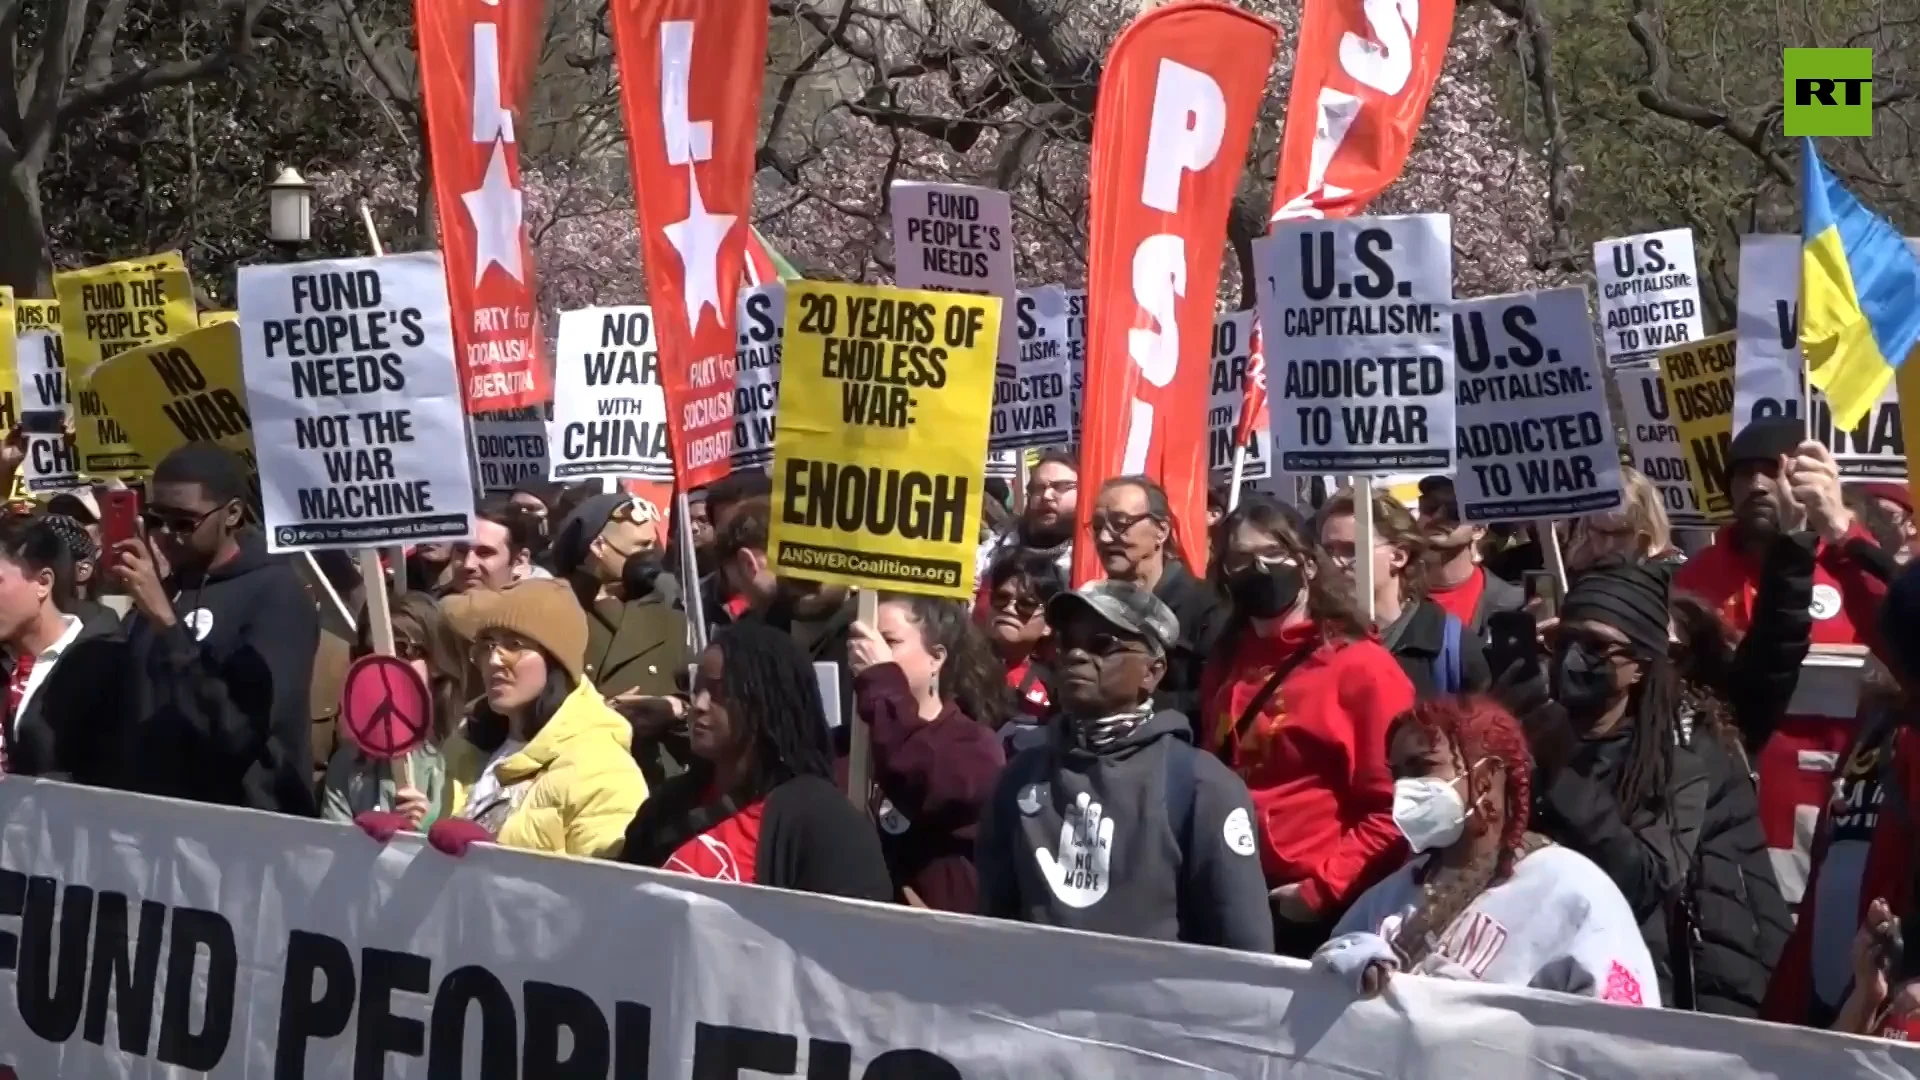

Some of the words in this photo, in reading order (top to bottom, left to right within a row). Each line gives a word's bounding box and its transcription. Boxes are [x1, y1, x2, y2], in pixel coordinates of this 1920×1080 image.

[928, 191, 979, 222] FUND
[908, 218, 1001, 251] PEOPLE'S
[923, 247, 989, 278] NEEDS
[1300, 228, 1412, 300] U.S.
[1613, 239, 1676, 277] U.S.
[82, 283, 125, 312] FUND
[128, 279, 166, 307] THE
[292, 270, 381, 313] FUND
[1604, 273, 1692, 299] CAPITALISM:
[17, 305, 44, 325] ARS
[85, 309, 169, 342] PEOPLE'S
[264, 308, 425, 357] PEOPLE'S
[601, 313, 649, 348] NO
[798, 293, 837, 334] 20
[846, 296, 936, 344] YEARS
[944, 305, 985, 348] OF
[1284, 304, 1441, 337] CAPITALISM:
[1607, 299, 1695, 330] ADDICTED
[1452, 305, 1562, 373] U.S.
[1617, 329, 1640, 350] TO
[1643, 323, 1690, 346] WAR
[147, 347, 207, 397] NO
[291, 353, 405, 398] NEEDS
[584, 351, 658, 386] WAR
[822, 337, 948, 389] ENDLESS
[1284, 357, 1444, 399] ADDICTED
[1665, 350, 1700, 382] FOR
[1456, 366, 1593, 406] APITALISM:
[598, 397, 642, 416] WITH
[842, 382, 917, 428] WAR:
[1012, 404, 1057, 431] WAR
[295, 415, 350, 449] NOT
[358, 409, 414, 444] THE
[563, 420, 672, 460] CHINA
[1297, 406, 1332, 446] TO
[1342, 405, 1428, 445] WAR
[1456, 411, 1604, 459] ADDICTED
[323, 447, 395, 483] WAR
[478, 435, 545, 458] DDICTED
[1472, 463, 1513, 497] TO
[1516, 455, 1597, 495] WAR
[297, 480, 434, 519] MACHINE
[783, 458, 968, 543] ENOUGH
[781, 547, 956, 584] ANSWERCoalition.org
[1064, 870, 1099, 891] MORE
[1075, 852, 1092, 872] NO
